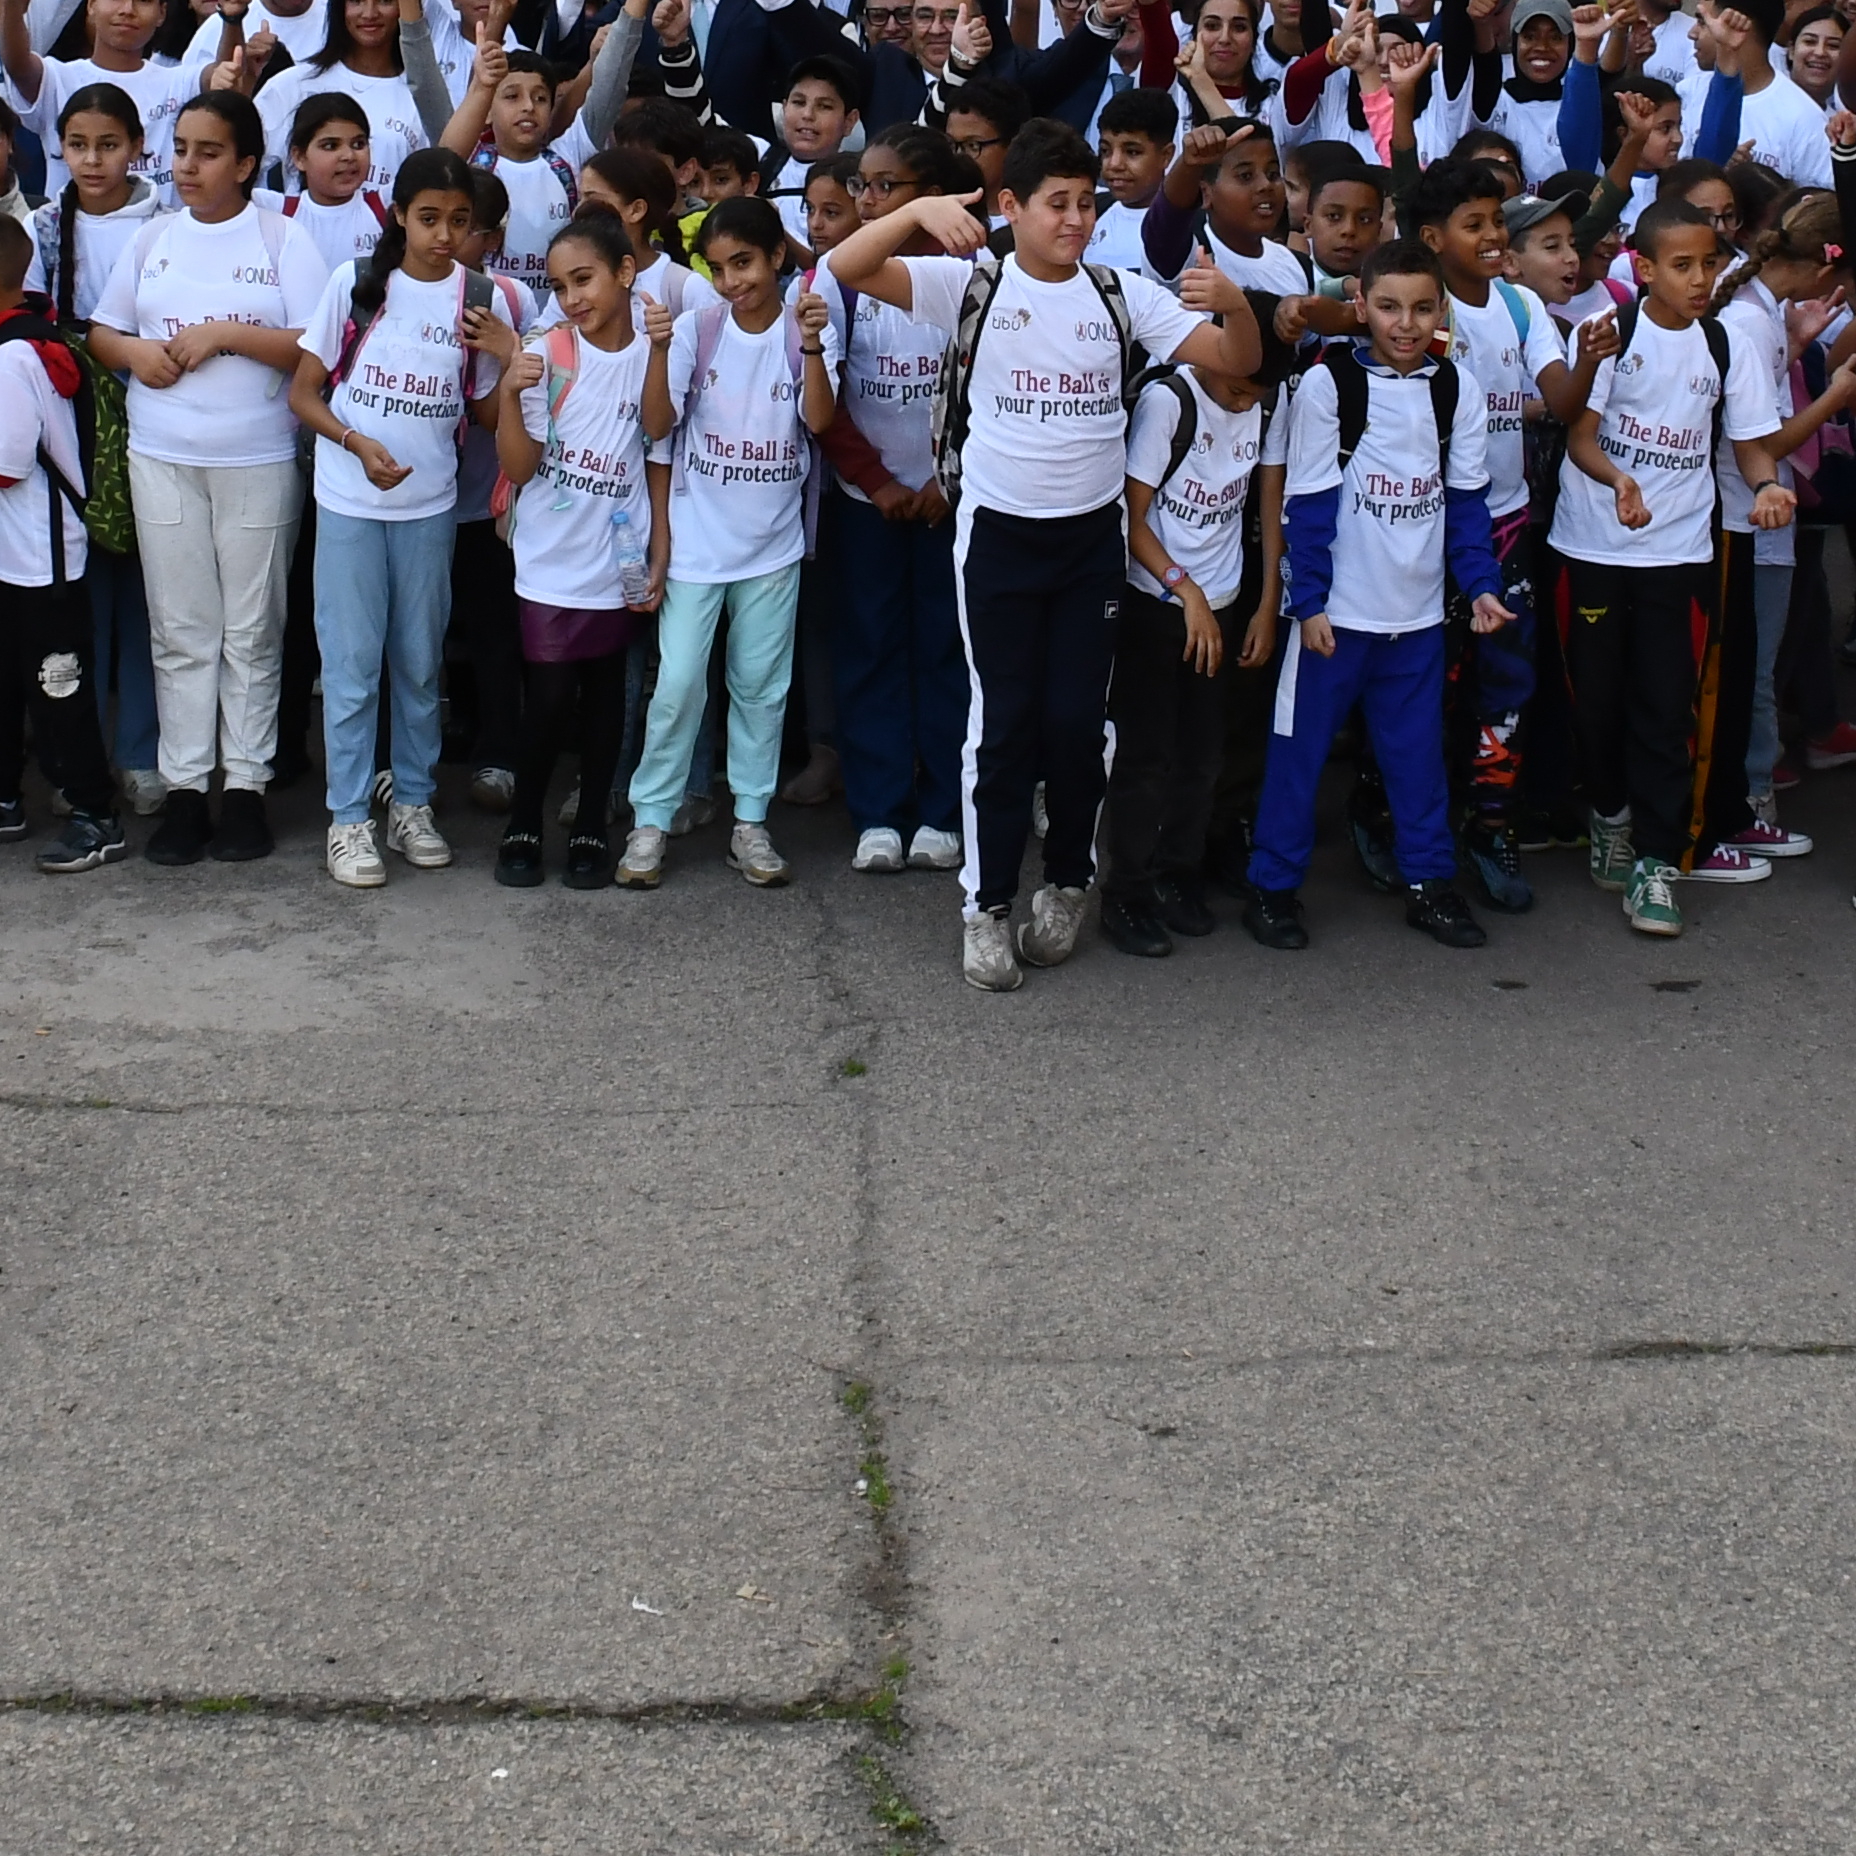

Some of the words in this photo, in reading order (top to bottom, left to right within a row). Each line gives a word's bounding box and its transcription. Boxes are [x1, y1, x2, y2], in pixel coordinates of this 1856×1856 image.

[876, 355, 911, 377] The
[364, 364, 397, 390] The
[404, 372, 438, 397] Ball
[860, 377, 895, 399] your
[1011, 370, 1050, 393] The
[1058, 373, 1094, 394] Ball
[1098, 372, 1110, 393] is
[382, 393, 460, 418] protection
[994, 394, 1034, 418] your
[1040, 393, 1120, 423] protection
[1618, 413, 1652, 442] The
[1656, 424, 1691, 450] Ball
[704, 433, 735, 459] The
[741, 440, 777, 461] Ball
[782, 440, 796, 460] is
[581, 447, 612, 473] Ball
[614, 457, 626, 477] is
[686, 451, 719, 477] your
[1183, 478, 1218, 508] The
[1366, 473, 1404, 497] The
[1158, 492, 1198, 523] your
